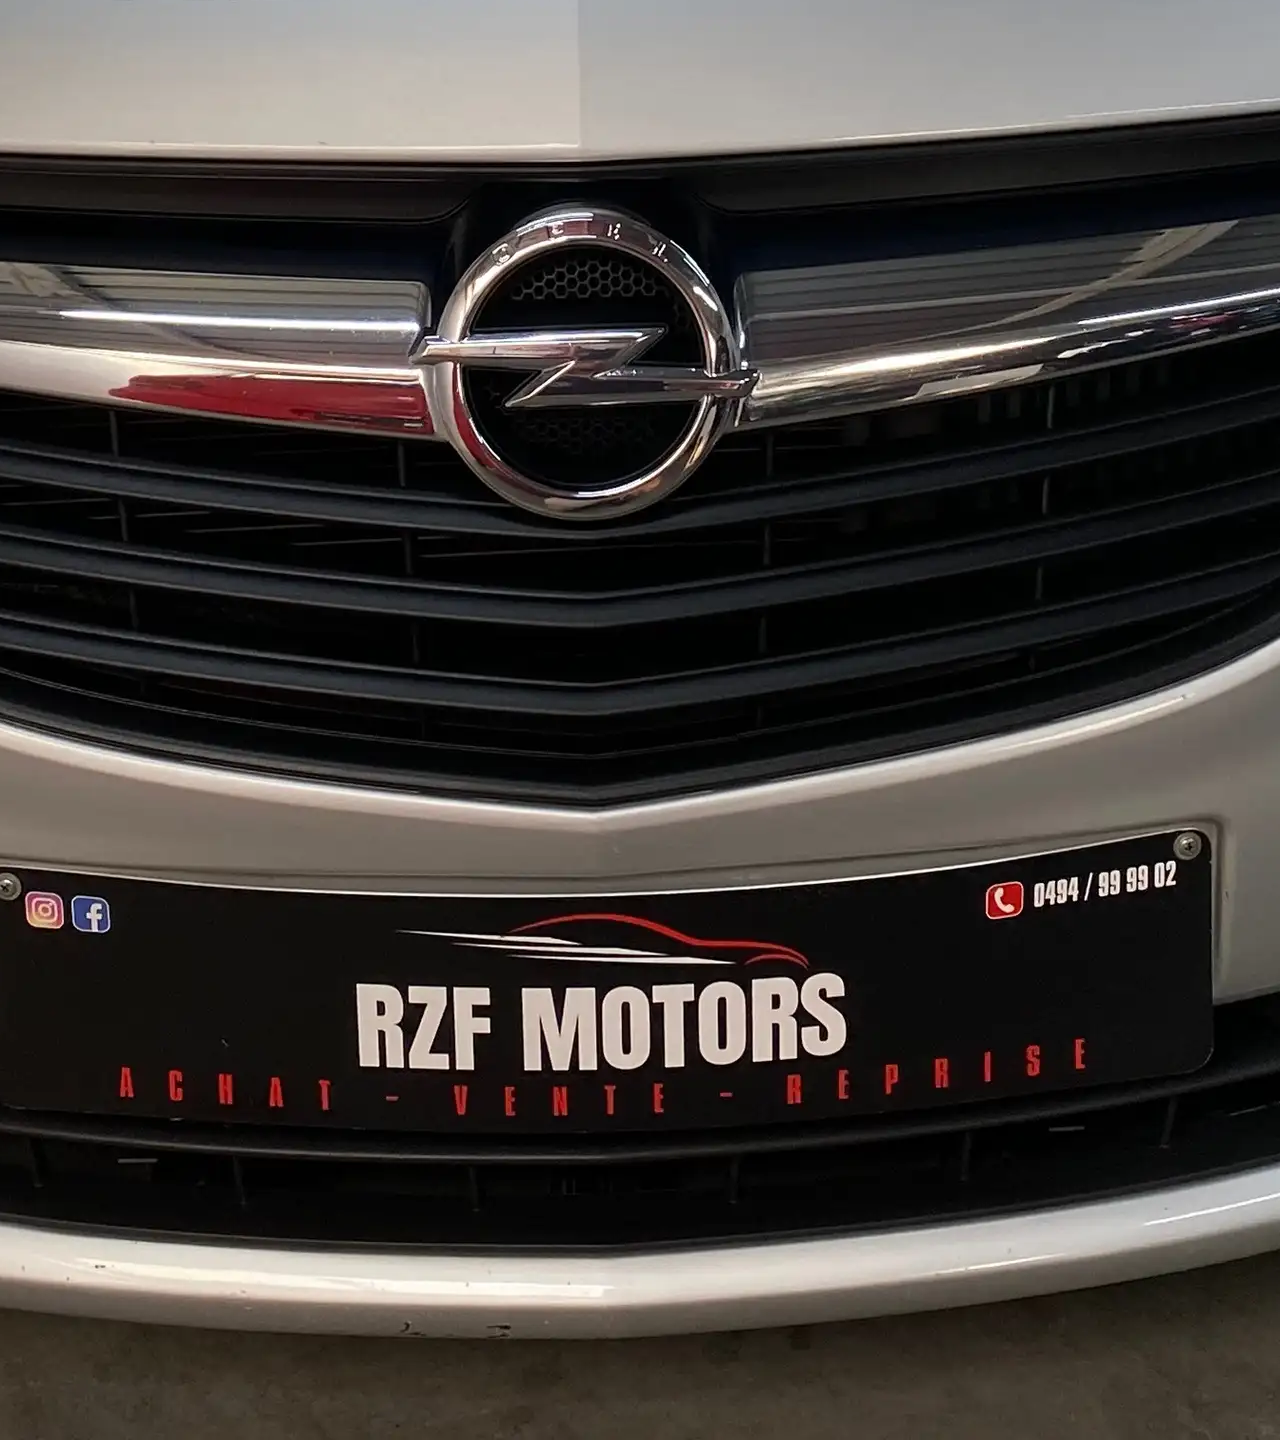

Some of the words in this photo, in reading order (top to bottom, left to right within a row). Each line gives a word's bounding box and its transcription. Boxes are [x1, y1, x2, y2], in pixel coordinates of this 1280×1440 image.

[1033, 877, 1080, 908] 0494
[1098, 870, 1121, 897] 99
[1126, 865, 1150, 893] 99
[1154, 860, 1177, 889] 02
[356, 983, 491, 1071] RZF
[521, 972, 847, 1071] MOTORS
[119, 1065, 332, 1111] ACHAT
[452, 1083, 665, 1118] VENTE
[784, 1037, 1087, 1105] REPRISE
